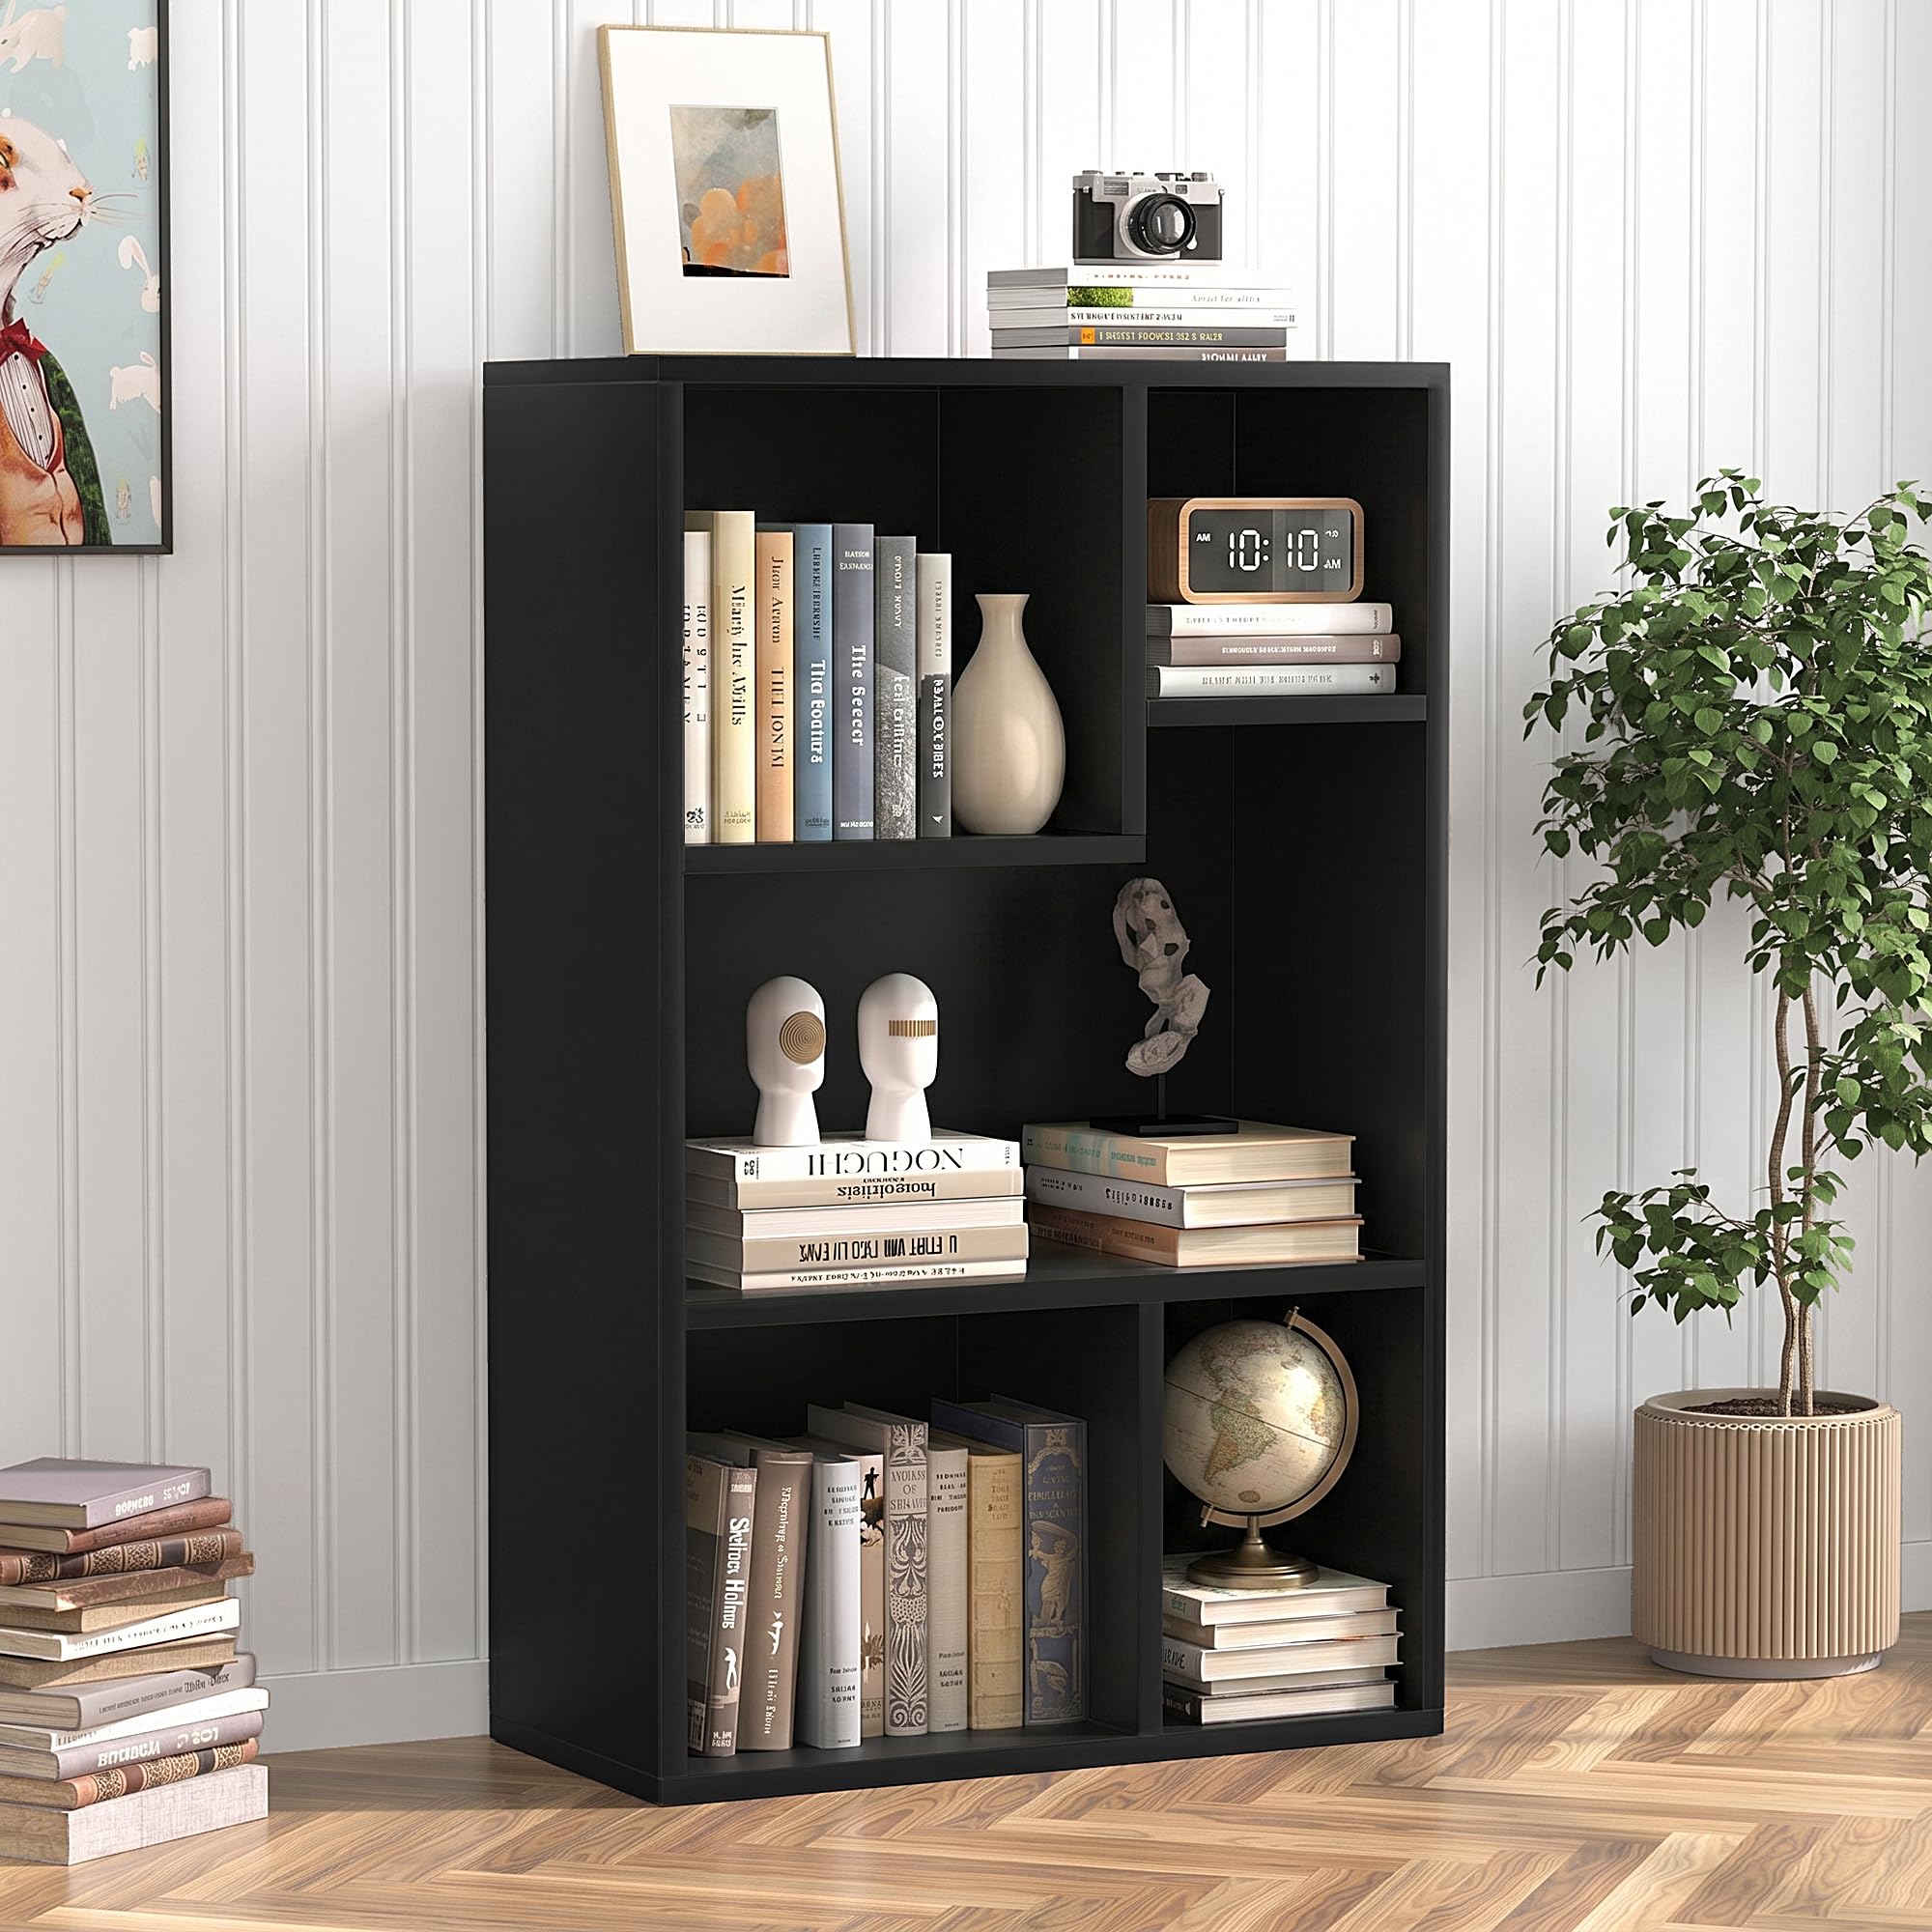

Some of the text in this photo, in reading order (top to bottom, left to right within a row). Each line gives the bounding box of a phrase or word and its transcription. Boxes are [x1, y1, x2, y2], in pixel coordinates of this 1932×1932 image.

[1196, 532, 1211, 542] AM
[1323, 558, 1342, 570] AM
[808, 1148, 964, 1177] NOGUCHI
